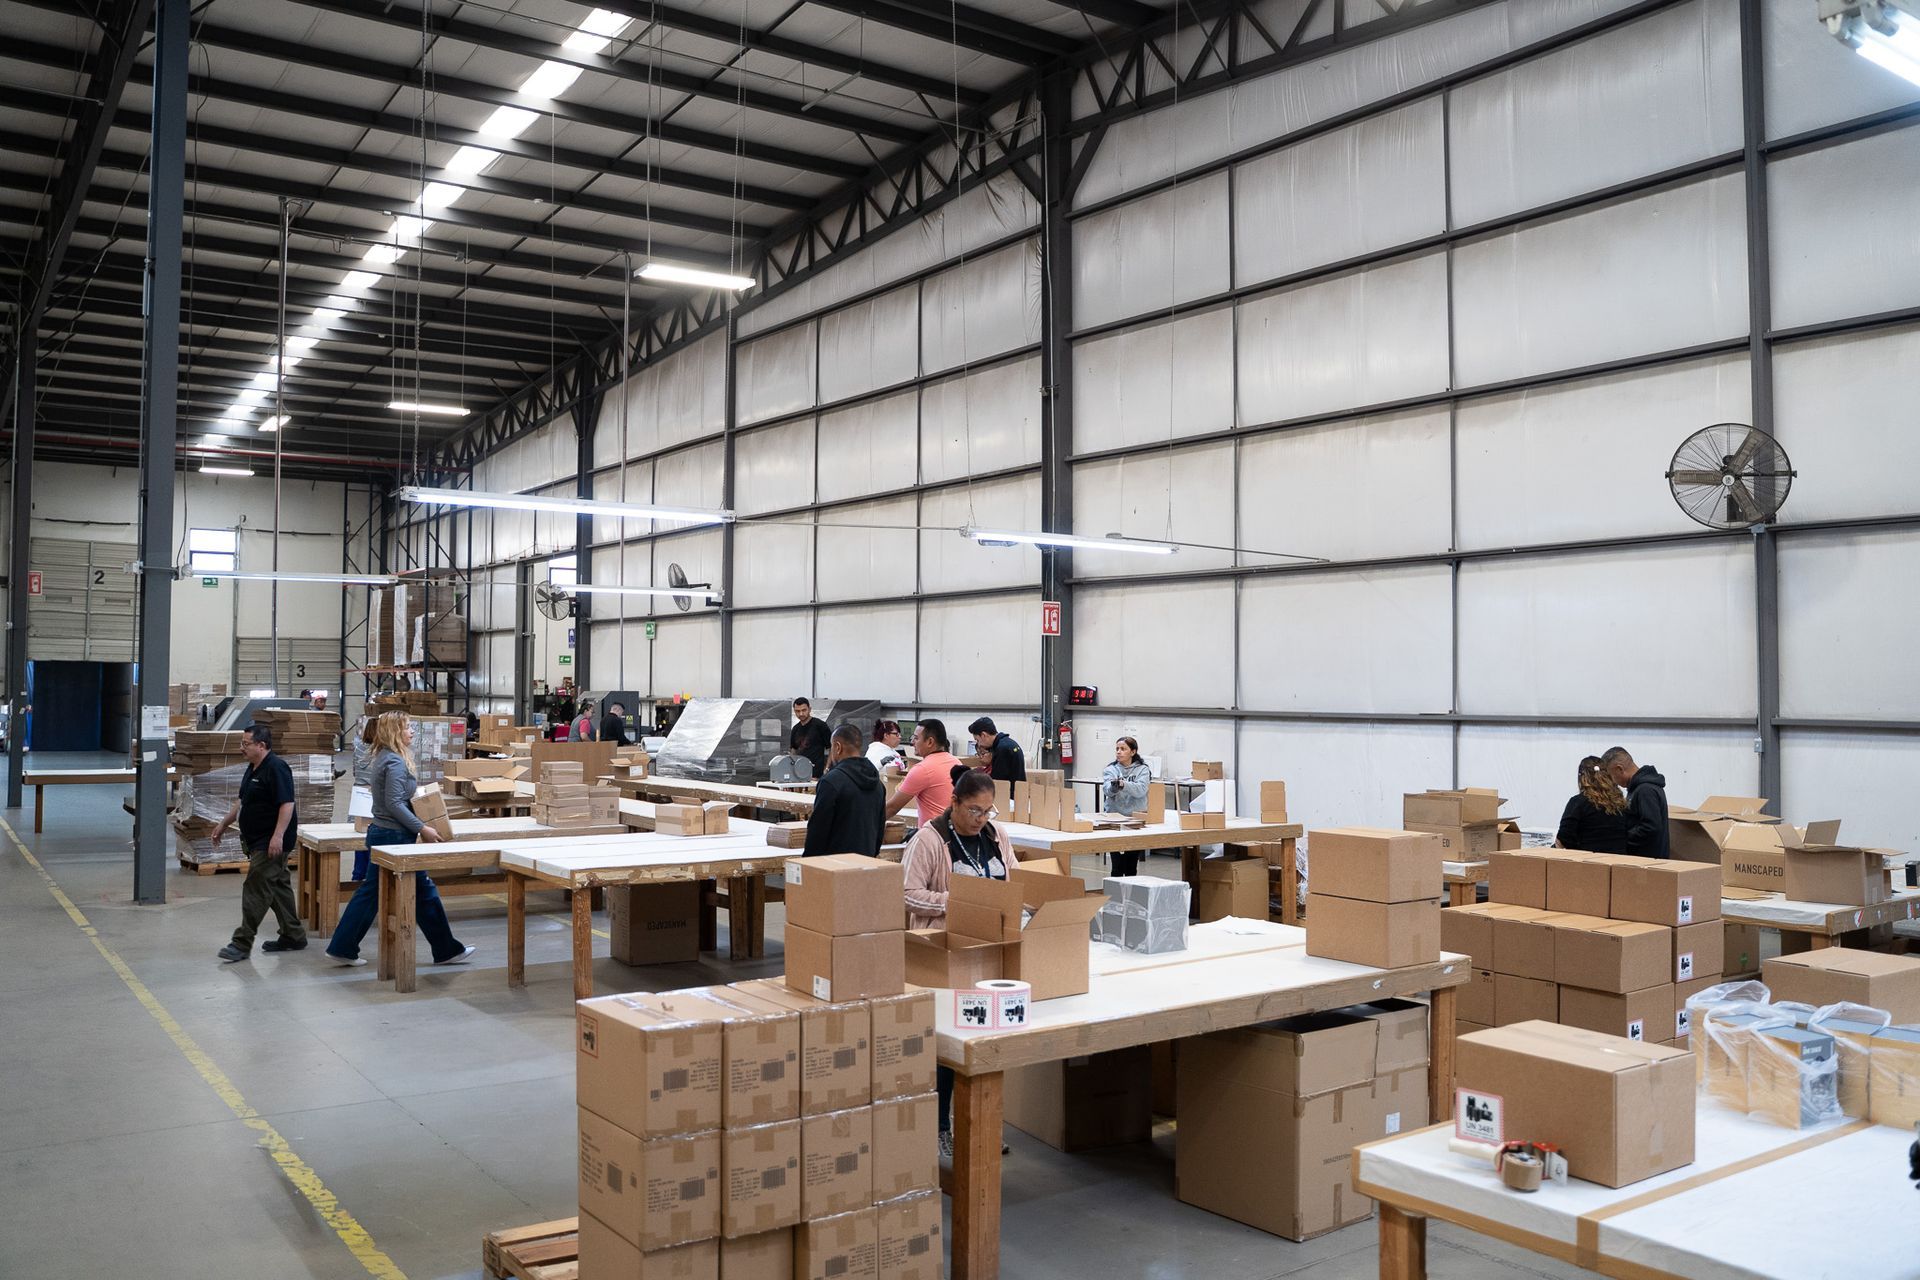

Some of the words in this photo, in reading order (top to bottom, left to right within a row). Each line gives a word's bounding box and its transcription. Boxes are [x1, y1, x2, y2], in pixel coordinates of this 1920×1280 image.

[95, 570, 105, 584] 2
[297, 665, 305, 678] 3
[1734, 863, 1784, 877] MANSCAPED
[1466, 1122, 1477, 1130] UN
